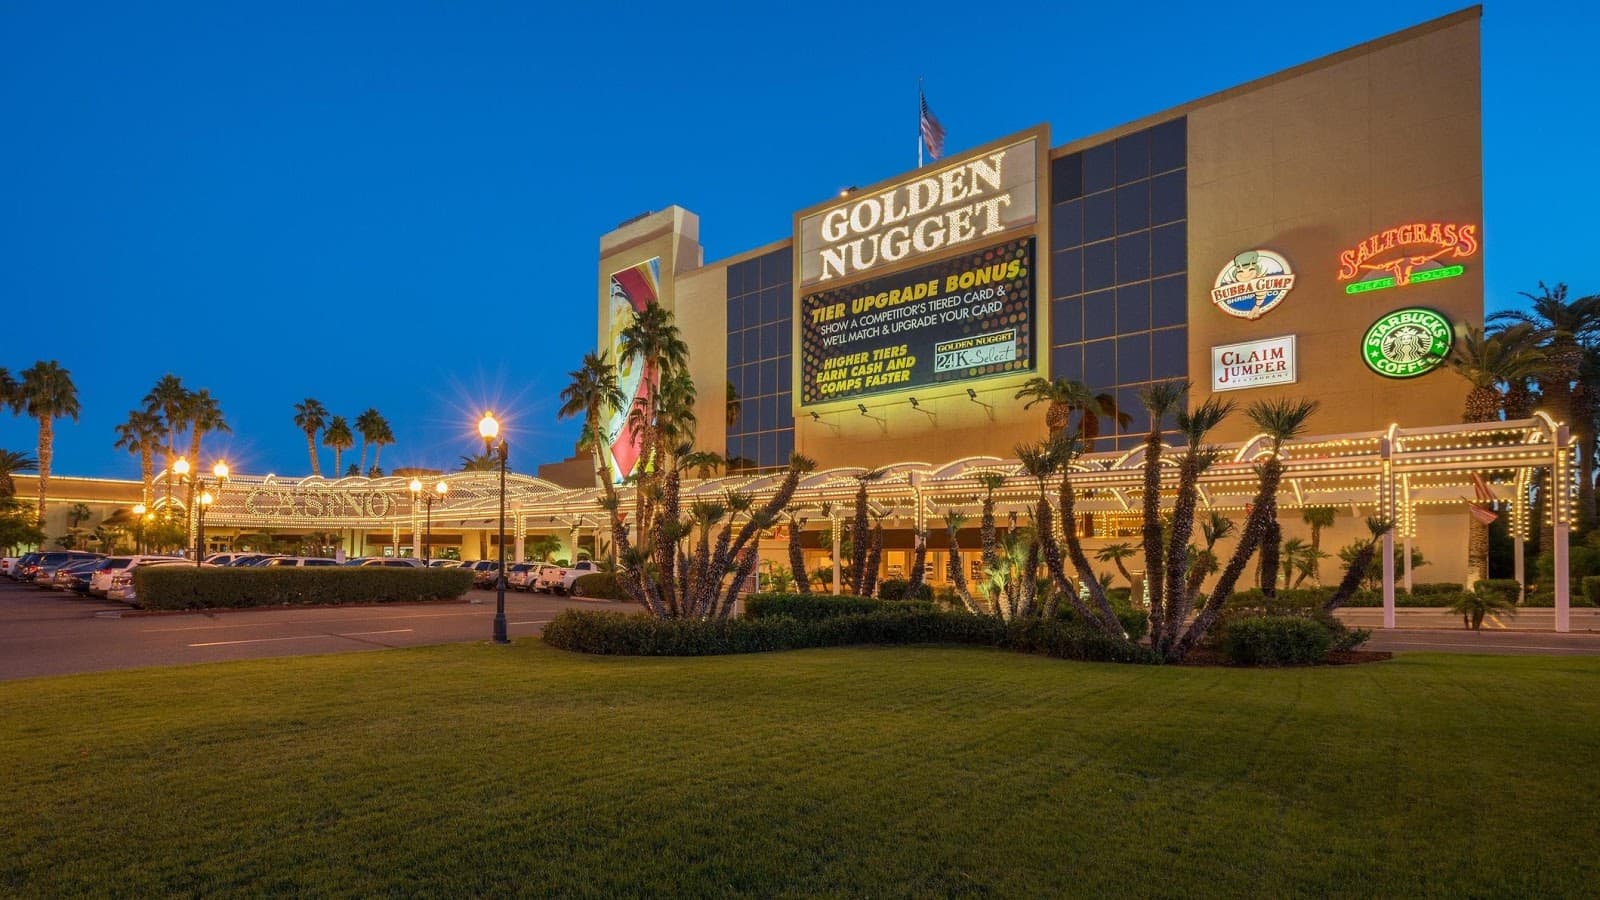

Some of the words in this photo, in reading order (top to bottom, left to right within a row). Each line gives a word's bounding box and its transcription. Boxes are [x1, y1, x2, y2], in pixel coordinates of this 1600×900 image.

[821, 151, 1006, 242] GOLDEN
[820, 193, 1011, 281] NUGGET
[1338, 223, 1477, 280] SALTGRASS
[811, 303, 846, 324] TIER
[851, 279, 939, 314] UPGRADE
[1214, 282, 1254, 302] BUBBA
[1256, 278, 1292, 291] GUMP
[820, 319, 849, 335] SHOW
[850, 319, 858, 329] A
[859, 302, 926, 327] COMPETITOR'S
[928, 295, 961, 311] TIERED
[963, 288, 994, 304] CARD
[996, 285, 1006, 297] &
[822, 333, 847, 346] WE'LL
[848, 326, 880, 342] MATCH
[881, 324, 890, 335] &
[891, 314, 937, 333] UPGRADE
[939, 307, 969, 323] YOUR
[971, 301, 1003, 316] CARD
[937, 339, 974, 353] GOLDEN
[975, 332, 1014, 346] NUGGET
[1368, 313, 1446, 347] STARBUCKS
[823, 351, 869, 370] HIGHER
[872, 344, 908, 361] TIERS
[969, 345, 1014, 364] Select
[1221, 347, 1284, 366] CLAIM
[816, 368, 848, 383] EARN
[851, 361, 883, 377] CASH
[886, 356, 917, 371] AND
[821, 377, 862, 394] COMPS
[865, 370, 911, 387] FASTER
[1218, 360, 1287, 383] JUMPER
[245, 487, 390, 518] CASINO
